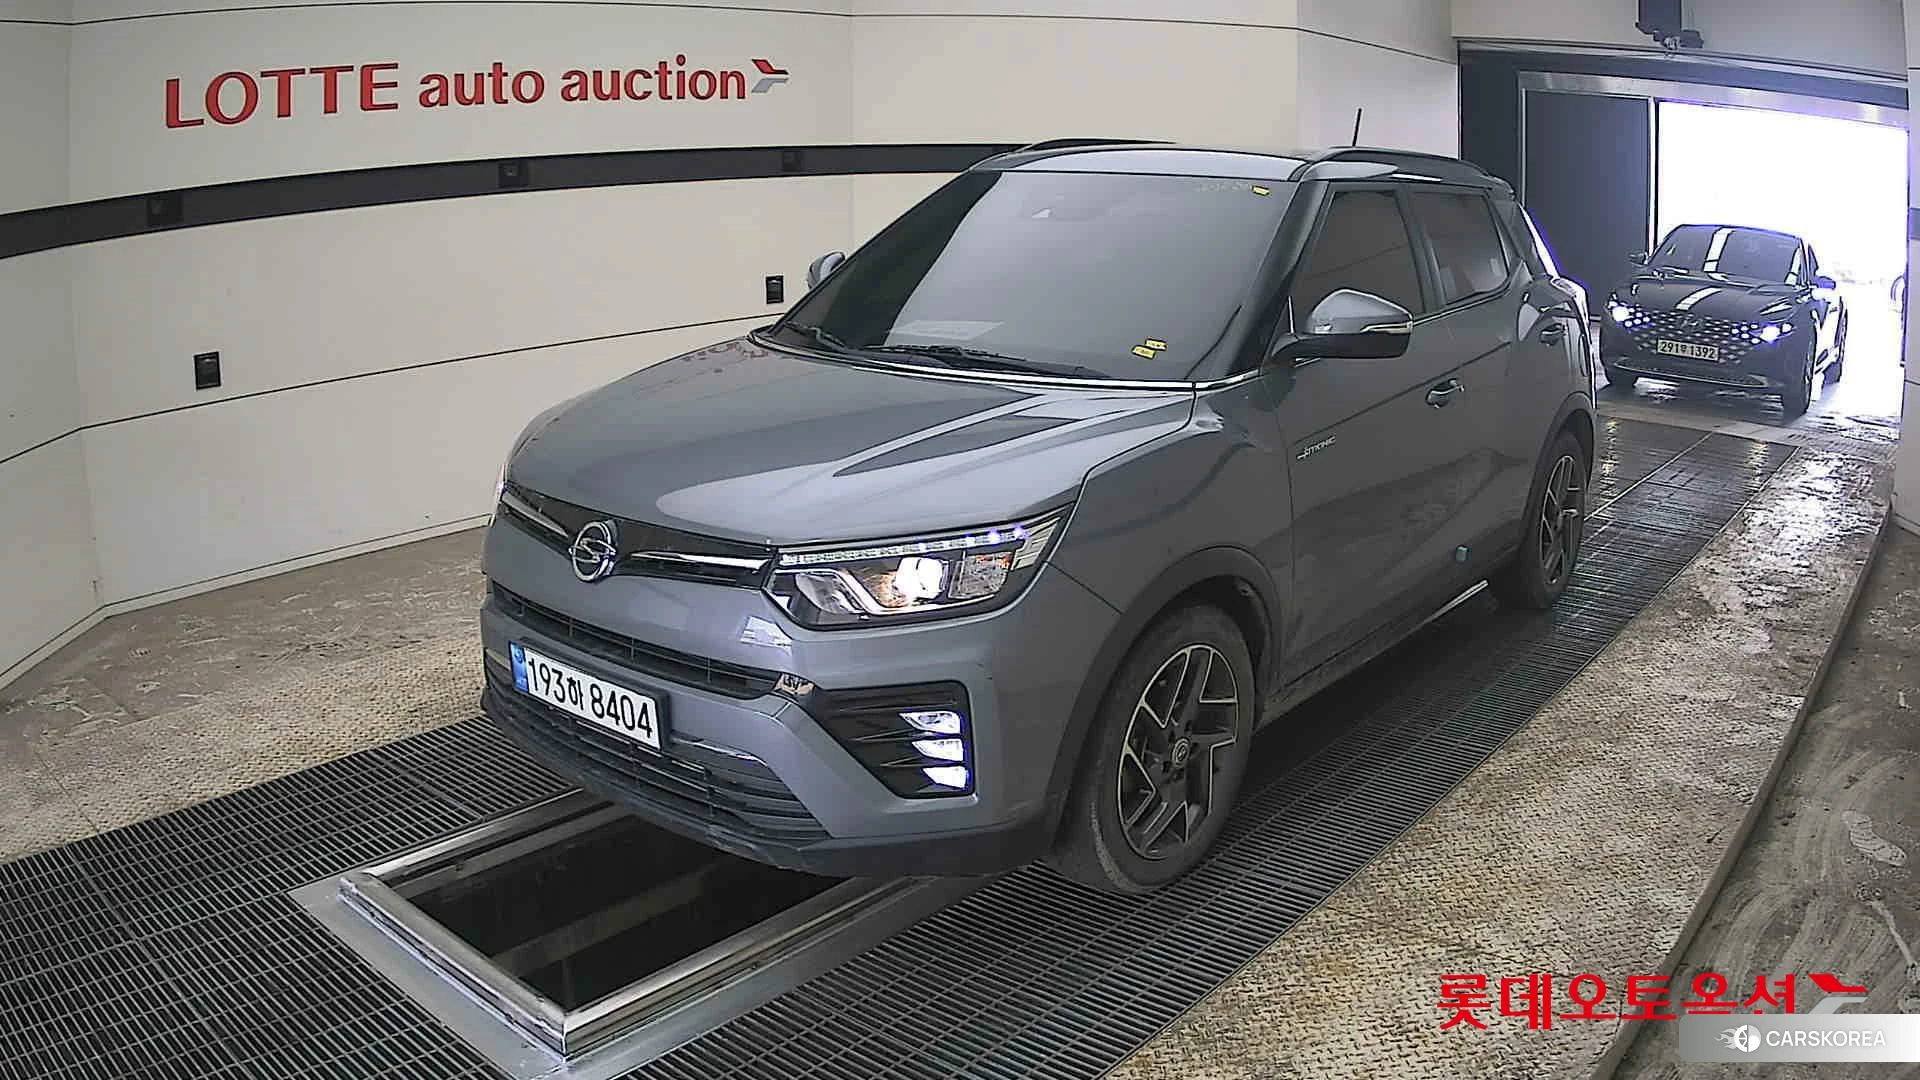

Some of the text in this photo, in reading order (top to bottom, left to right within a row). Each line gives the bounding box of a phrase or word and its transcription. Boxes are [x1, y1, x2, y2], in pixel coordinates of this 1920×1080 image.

[165, 54, 747, 129] LOTTE auto auction
[1689, 344, 1716, 359] 1392
[528, 657, 653, 739] 193하 8404
